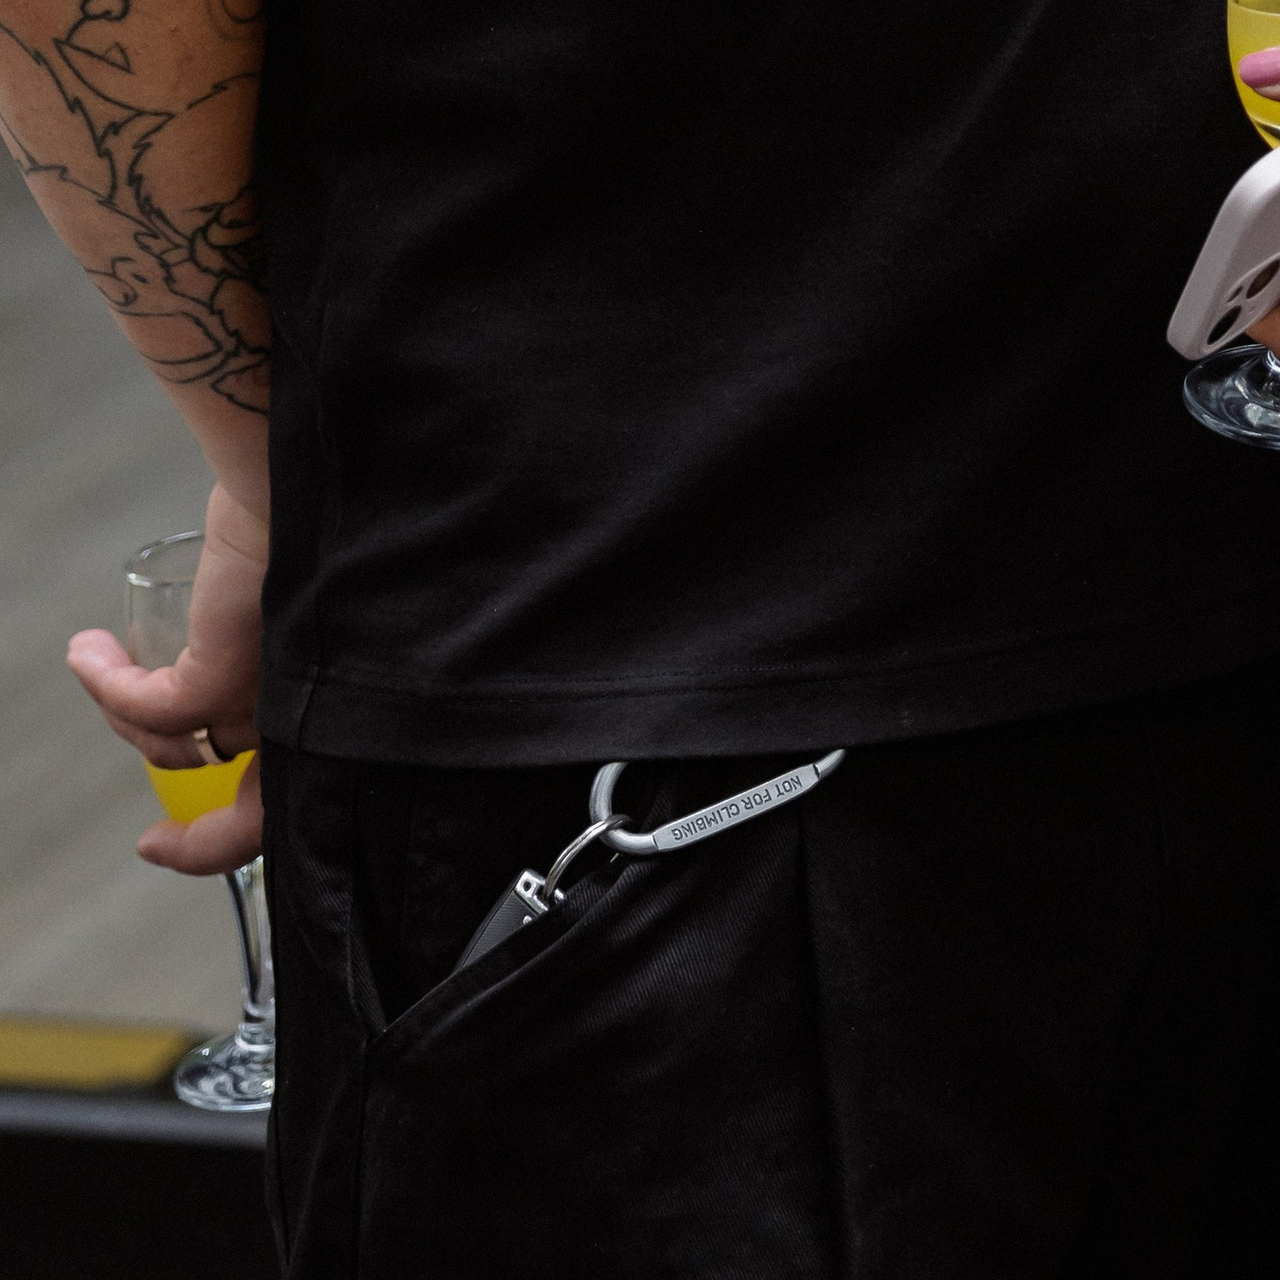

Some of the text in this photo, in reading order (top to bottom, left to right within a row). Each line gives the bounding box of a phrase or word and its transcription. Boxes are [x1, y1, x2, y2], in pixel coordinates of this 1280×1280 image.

[670, 774, 803, 841] NOT FOR CLIMBING
